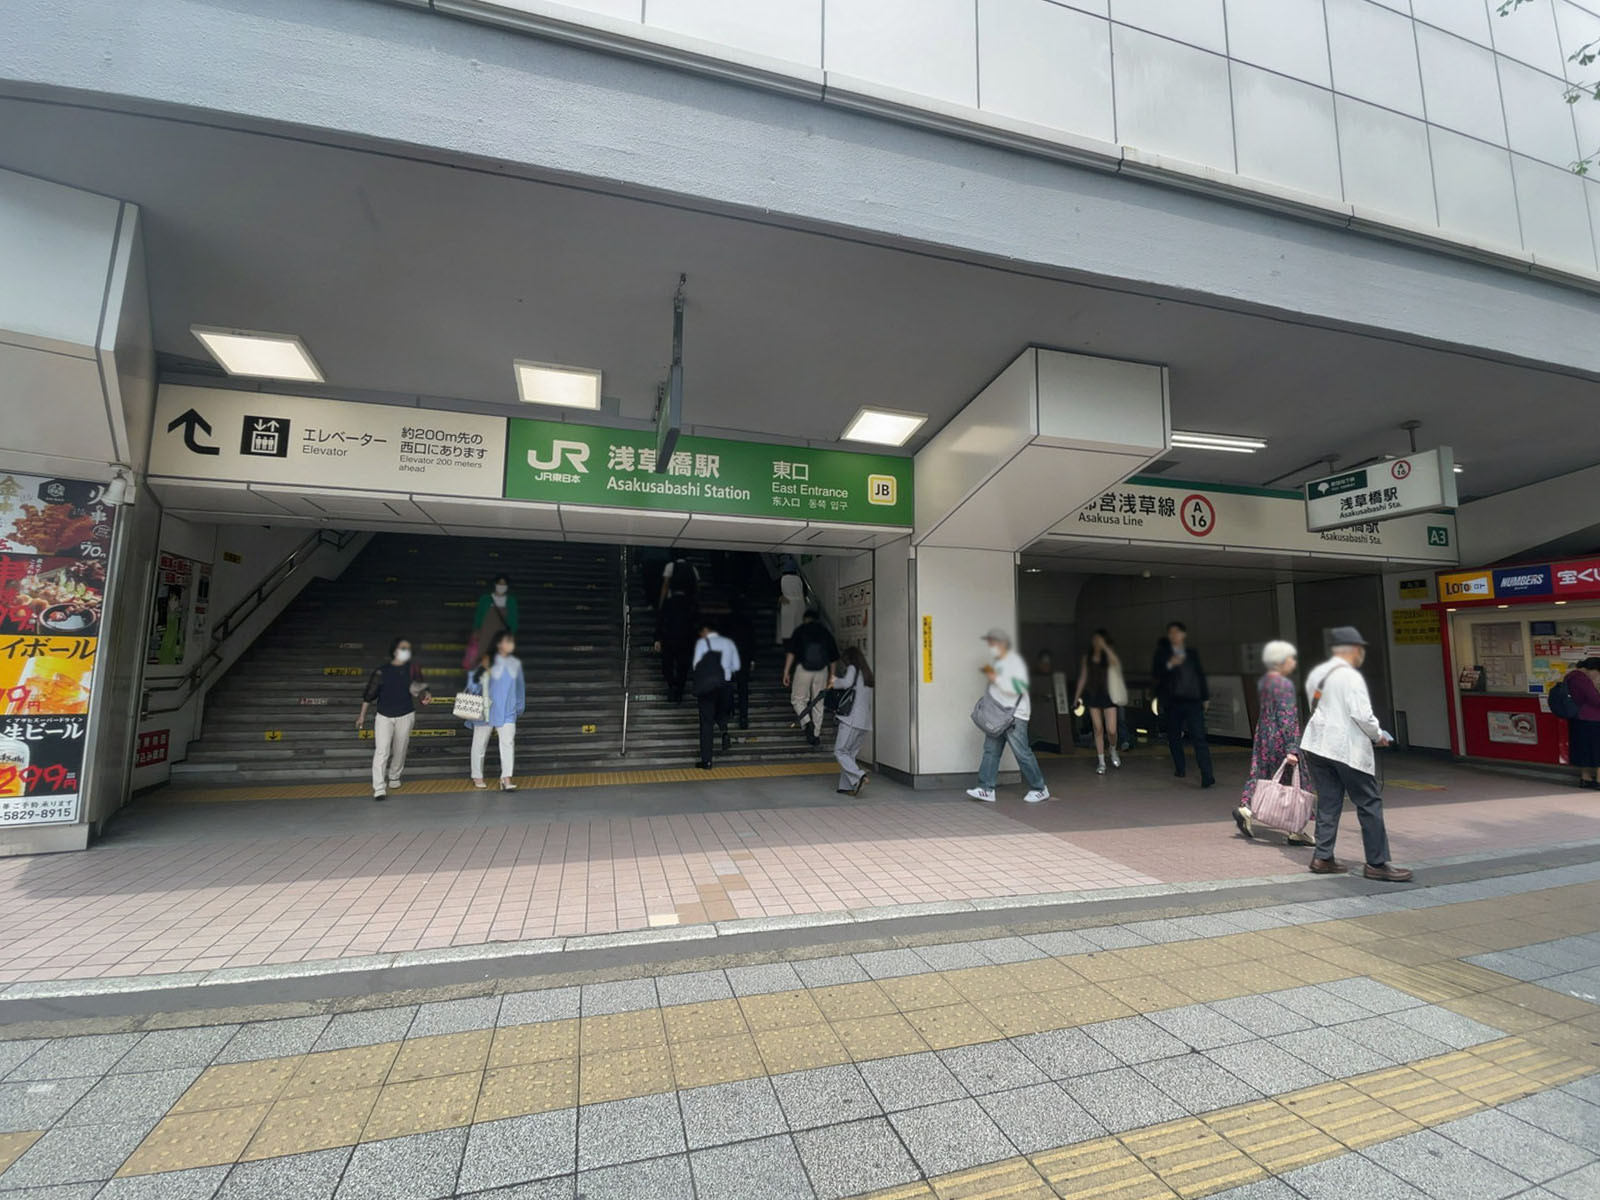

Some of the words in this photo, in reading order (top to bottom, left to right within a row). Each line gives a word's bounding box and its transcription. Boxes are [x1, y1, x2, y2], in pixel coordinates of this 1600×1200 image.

[303, 429, 387, 446] エレベーター
[401, 427, 483, 444] 約200m先の
[302, 444, 347, 456] Elevator
[400, 441, 488, 459] 西口にあります
[527, 439, 590, 473] JR
[399, 463, 426, 472] ahead
[400, 454, 434, 464] Elevator
[436, 458, 452, 466] 200
[454, 460, 482, 469] meters
[534, 472, 581, 484] JR東日本
[772, 461, 809, 481] 東口
[606, 476, 700, 497] Asakusabashi
[704, 483, 751, 500] Station
[772, 482, 797, 494] East
[800, 484, 848, 498] Entrance
[874, 483, 890, 497] JB
[1340, 487, 1398, 510] 浅草橋駅
[1193, 501, 1203, 513] A
[1340, 503, 1387, 518] Asakusabashi
[1078, 512, 1120, 524] Asakusa
[1123, 515, 1144, 527] Line
[1191, 514, 1207, 528] 16
[1320, 531, 1368, 543] Asakusabashi
[1430, 530, 1446, 544] A3
[1446, 582, 1470, 595] LOTO
[1500, 574, 1544, 588] NUMBERS
[0, 637, 96, 659] イボール
[0, 685, 40, 713] 9円
[4, 722, 84, 740] 生ビール
